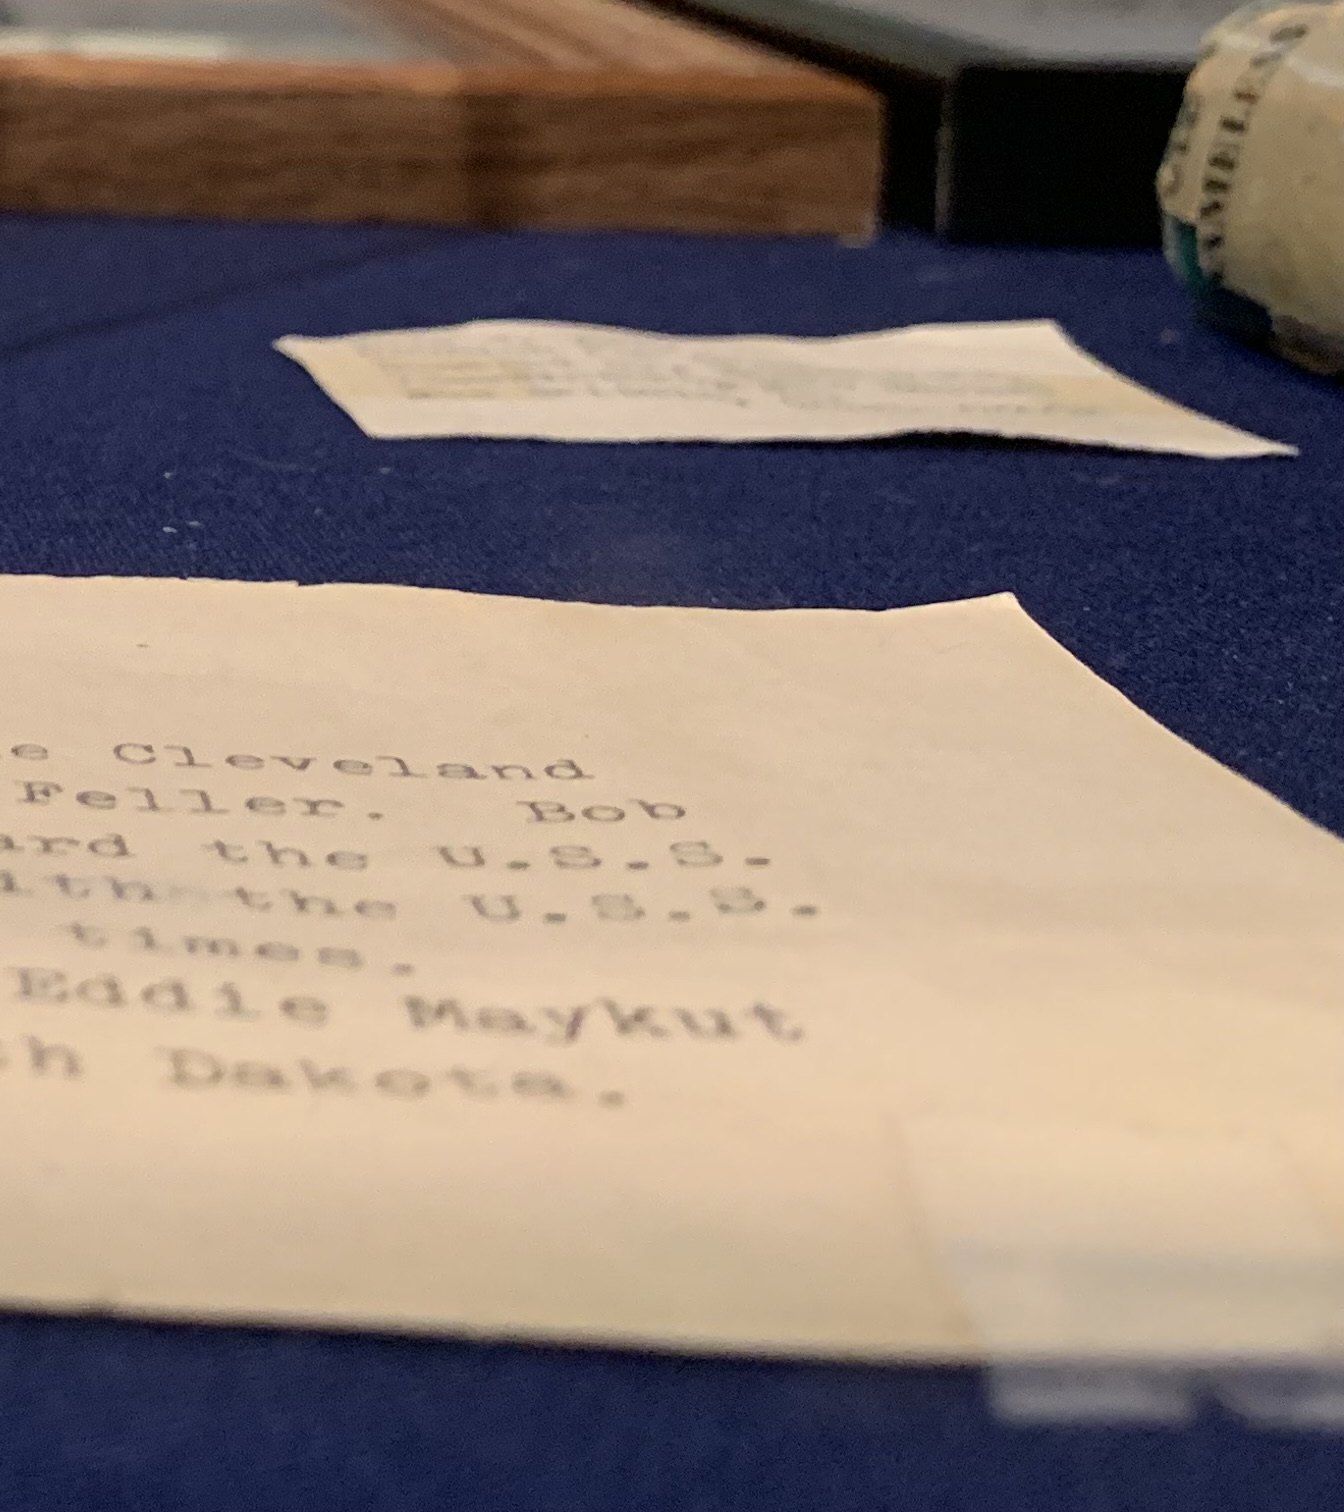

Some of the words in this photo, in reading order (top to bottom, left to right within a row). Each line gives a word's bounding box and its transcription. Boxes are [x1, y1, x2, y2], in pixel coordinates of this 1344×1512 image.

[114, 742, 596, 782] Cleveland
[20, 780, 388, 822] Feller.
[518, 798, 690, 826] Bob
[202, 836, 372, 872] the
[232, 882, 398, 922] the
[12, 962, 330, 1022] Eddie
[402, 992, 808, 1048] Maykut
[168, 1048, 628, 1108] Dakota.
